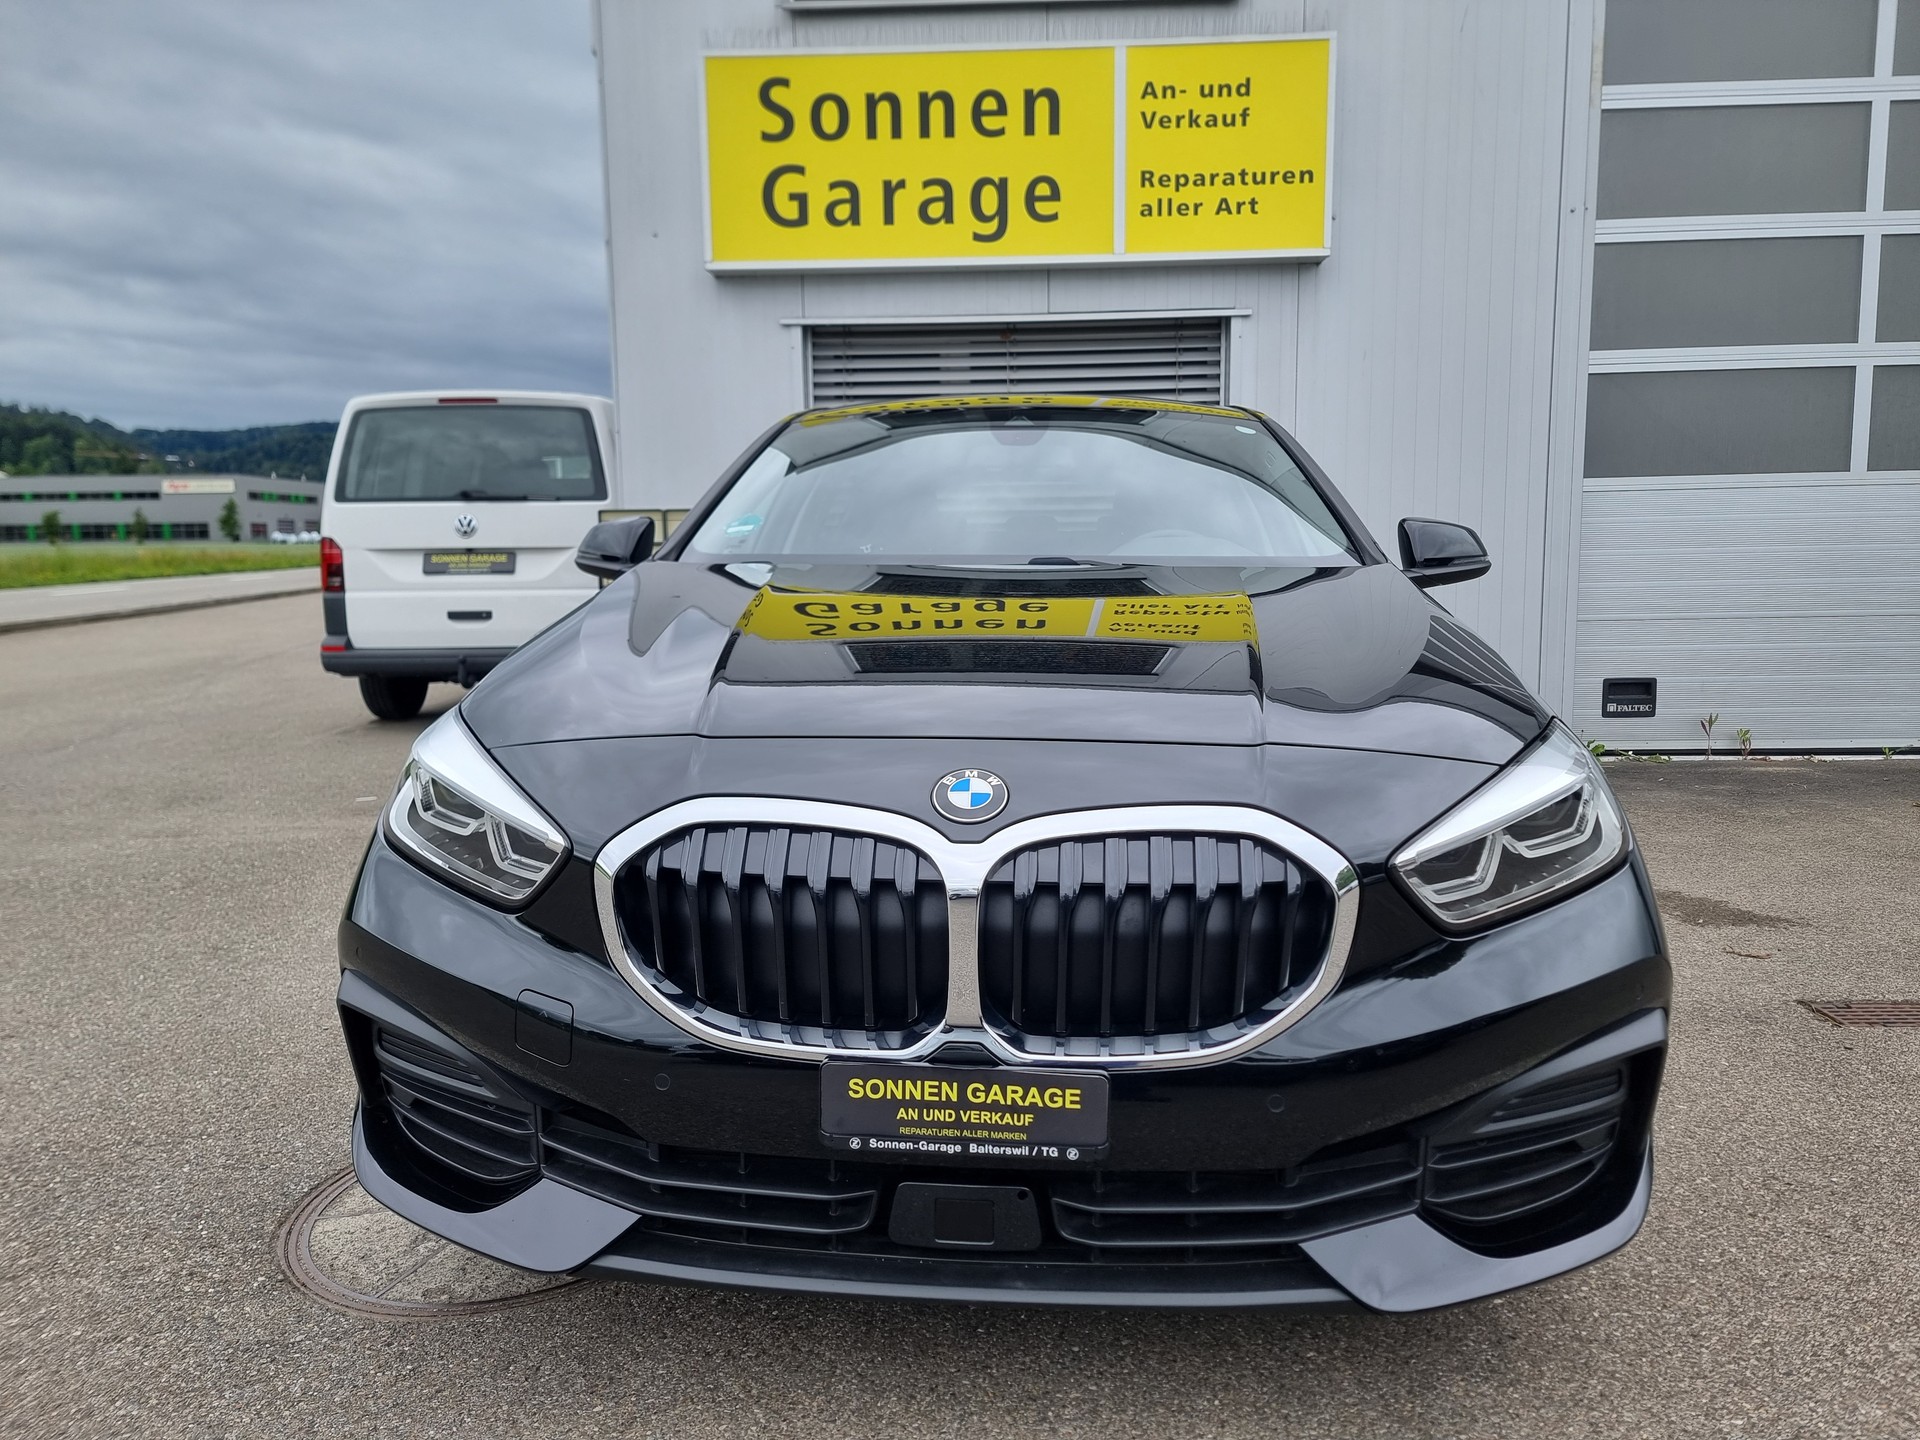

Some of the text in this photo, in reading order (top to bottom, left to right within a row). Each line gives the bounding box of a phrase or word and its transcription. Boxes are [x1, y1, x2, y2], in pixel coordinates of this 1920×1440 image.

[1140, 77, 1251, 100] An- und
[758, 76, 1062, 143] Sonnen
[1140, 107, 1250, 129] Verkauf
[1140, 168, 1314, 193] Reparaturen
[760, 163, 1062, 243] Garage
[1139, 197, 1259, 218] aller Art
[469, 553, 508, 563] GARAGE
[1616, 704, 1653, 712] FALTEC
[942, 770, 1001, 786] BMW
[848, 1078, 1081, 1109] SONNEN GARAGE
[896, 1108, 1034, 1126] AN UND VERKAUF
[899, 1127, 1027, 1141] REPARATUREN ALLER MARKEN
[869, 1138, 962, 1154] Sonnen-Garage
[969, 1143, 1029, 1156] Balterswil
[1041, 1146, 1058, 1157] TG
